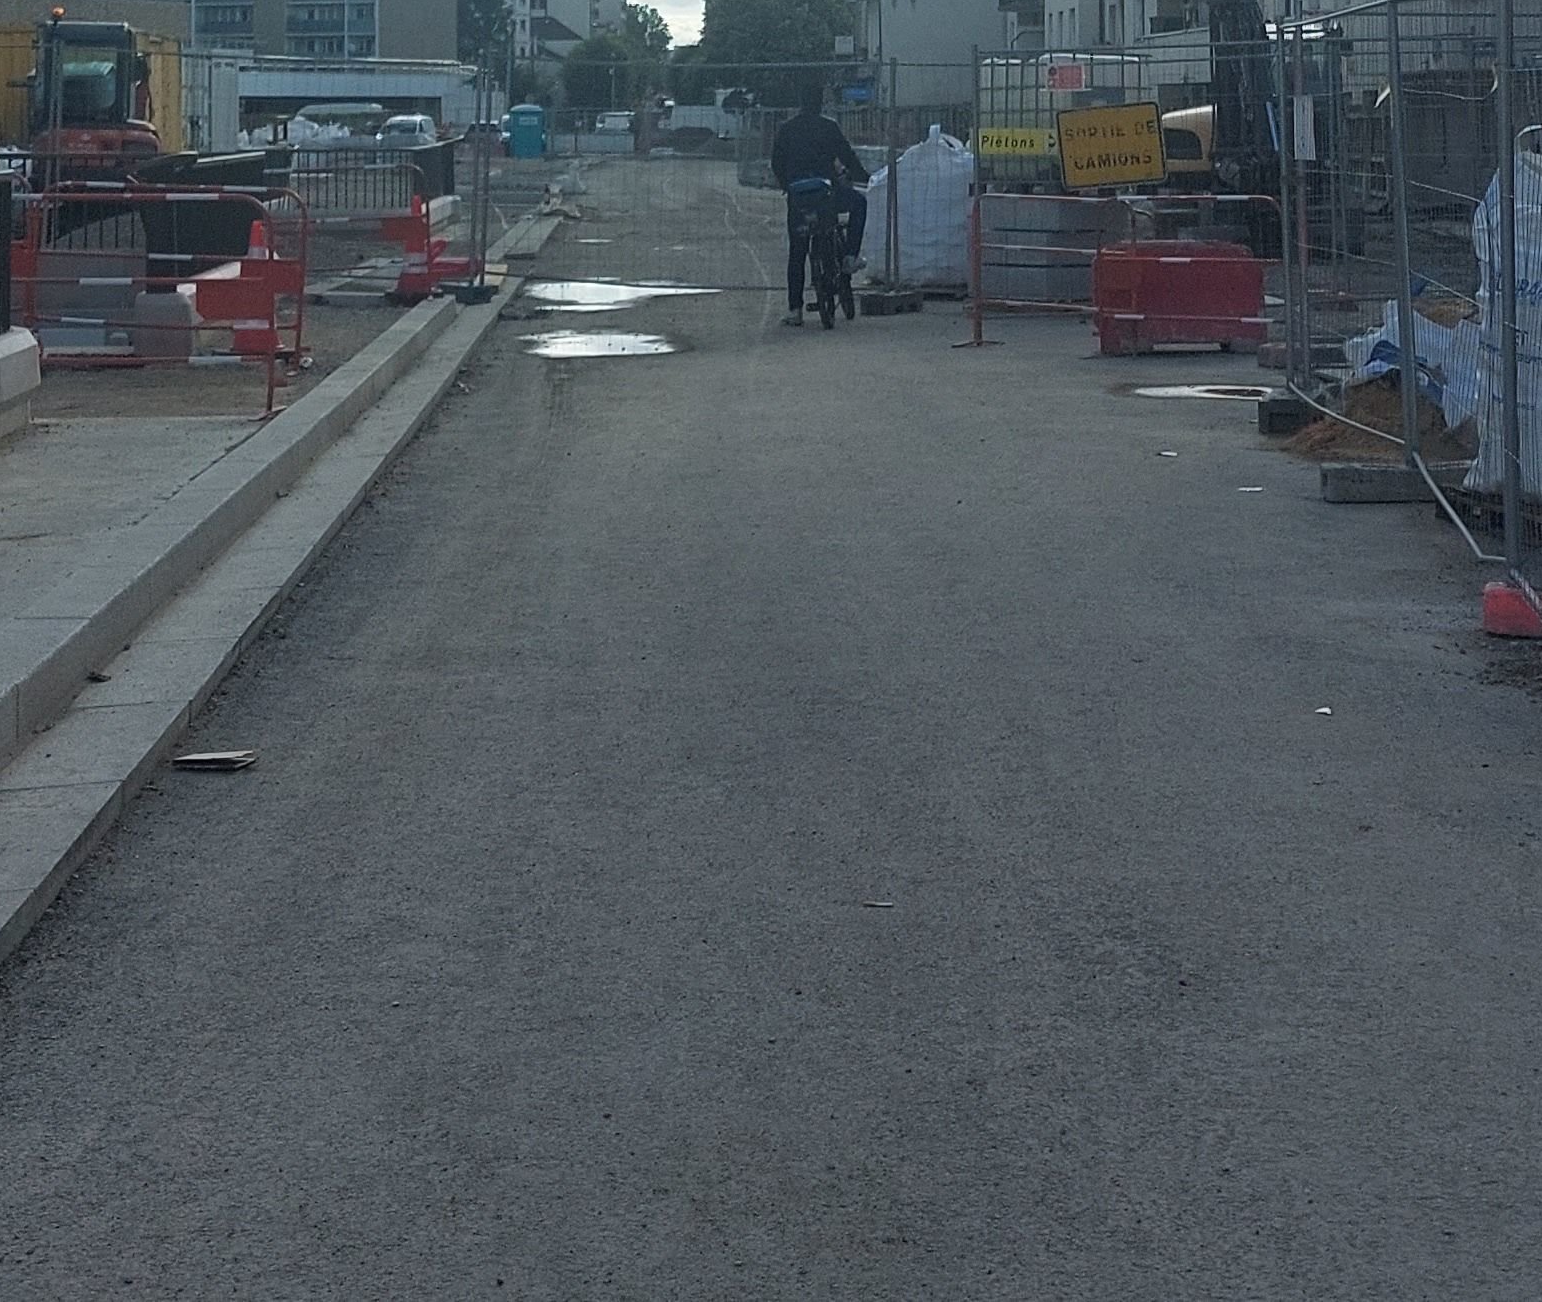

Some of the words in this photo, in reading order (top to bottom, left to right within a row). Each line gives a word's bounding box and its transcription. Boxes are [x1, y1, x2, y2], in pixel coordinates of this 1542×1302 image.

[1134, 119, 1158, 136] DE
[981, 135, 1036, 149] Piétons
[1073, 150, 1153, 171] CAMIONS
